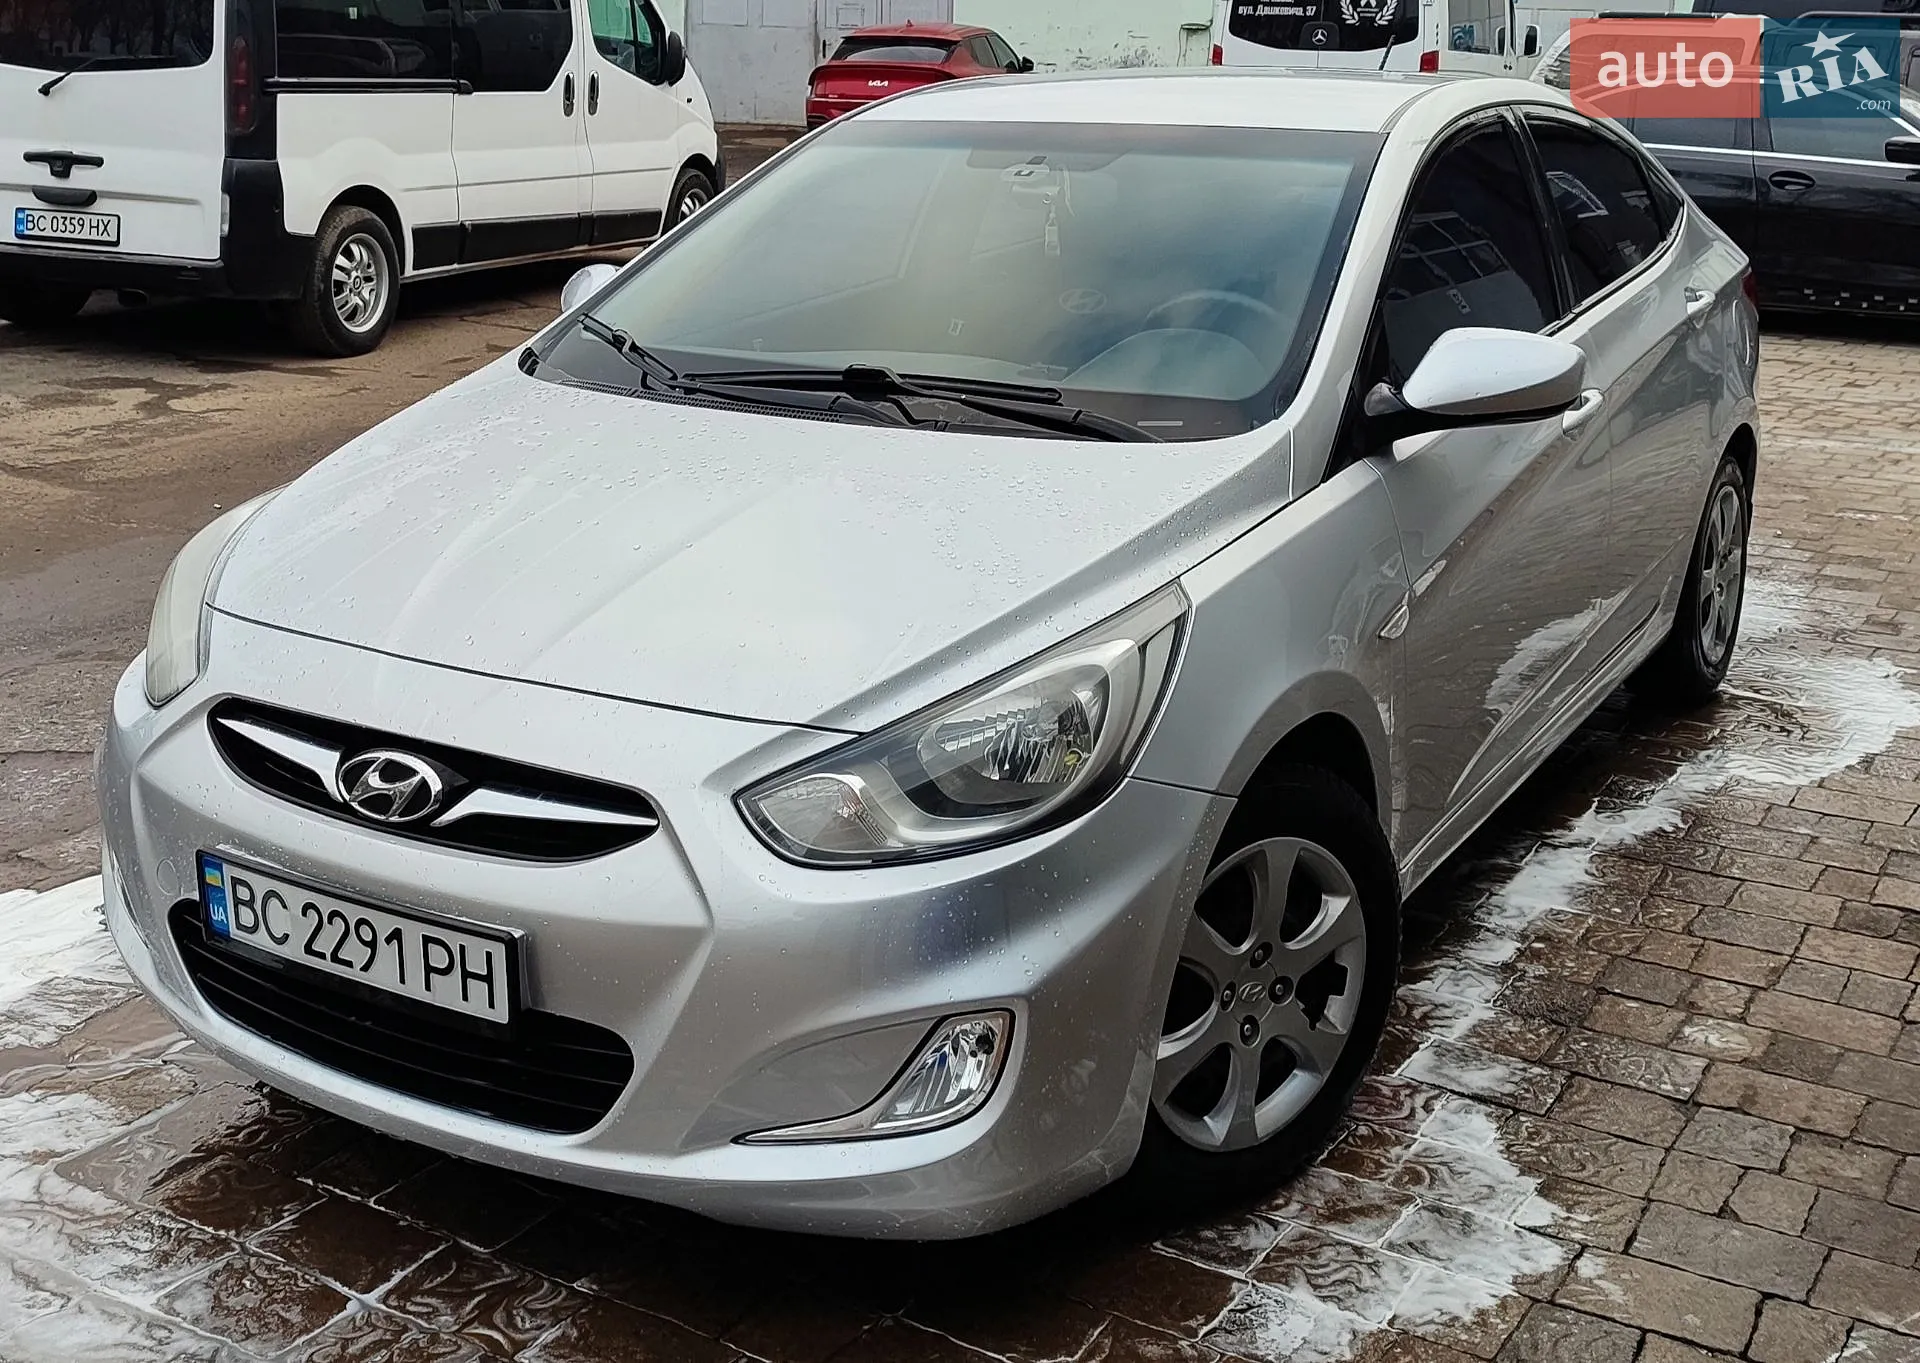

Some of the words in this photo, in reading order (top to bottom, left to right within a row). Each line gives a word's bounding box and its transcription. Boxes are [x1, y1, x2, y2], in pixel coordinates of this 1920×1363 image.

[1238, 5, 1254, 16] вул.
[1306, 5, 1316, 16] 37
[25, 213, 47, 232] BC
[50, 215, 85, 235] 0359
[88, 218, 111, 237] HX
[210, 903, 227, 924] UA
[230, 875, 290, 946] BC
[301, 901, 406, 985] 2291
[421, 933, 495, 1010] PH
